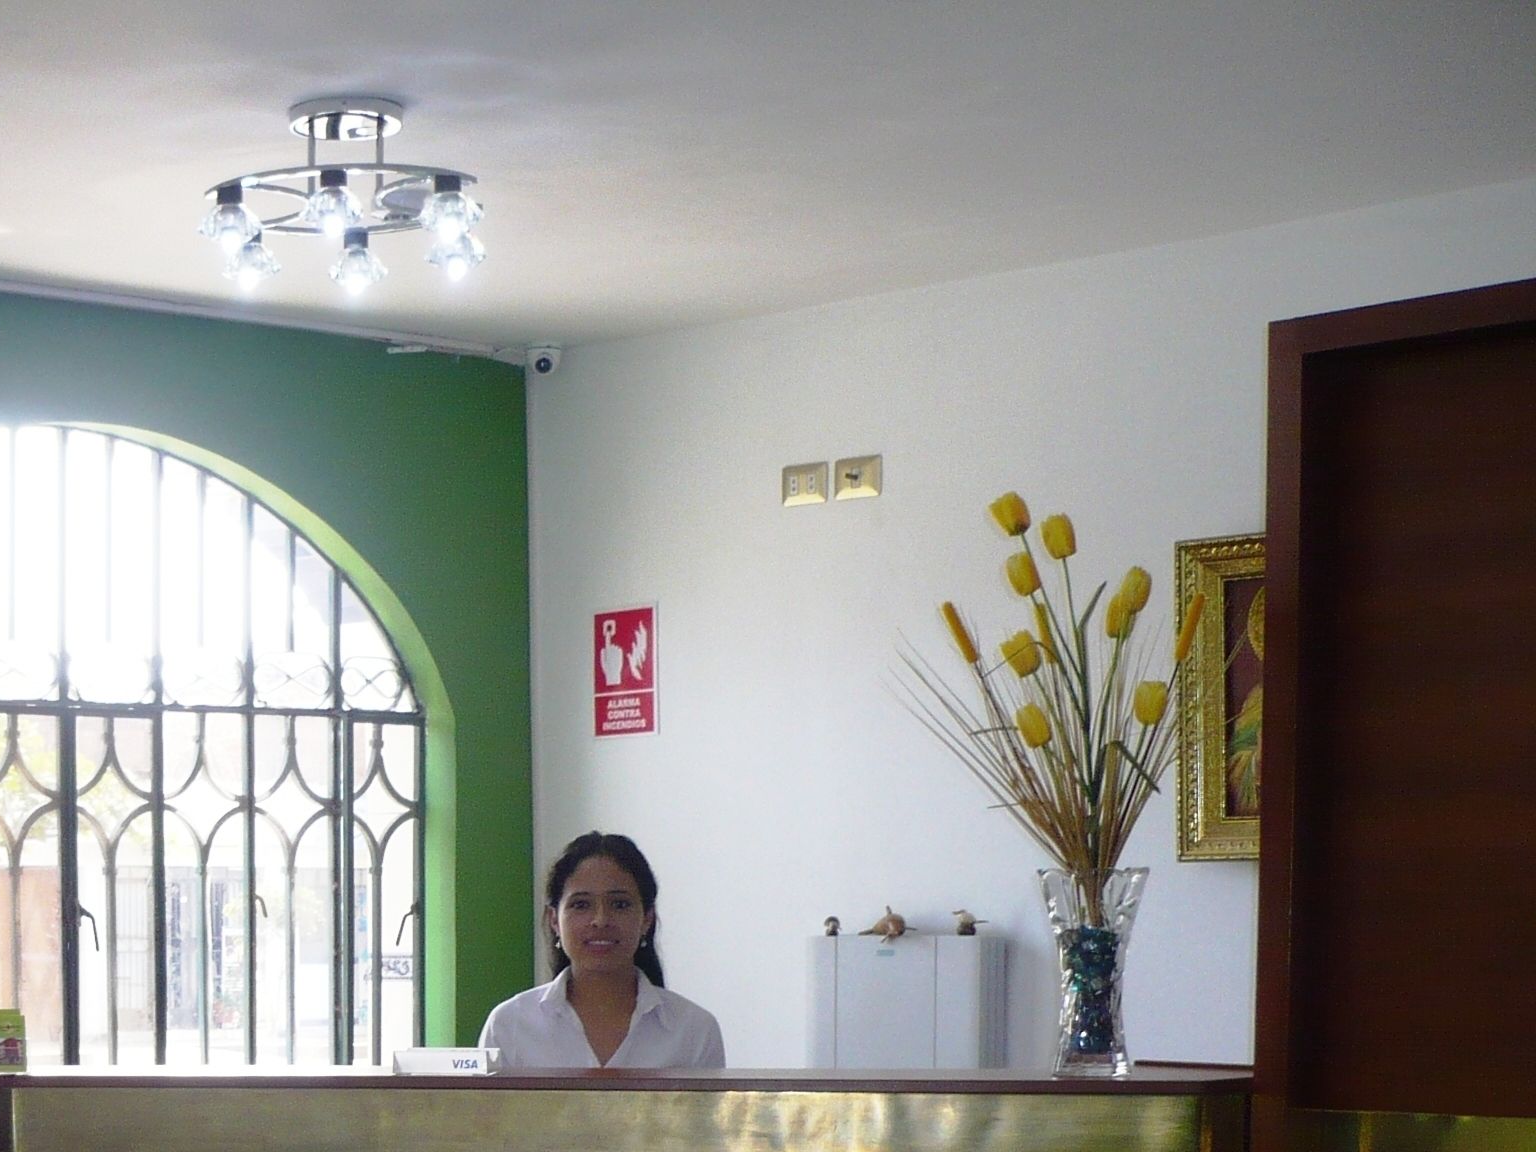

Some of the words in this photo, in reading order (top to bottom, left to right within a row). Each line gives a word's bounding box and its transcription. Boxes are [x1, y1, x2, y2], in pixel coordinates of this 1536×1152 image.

[607, 698, 640, 709] ALARMA
[607, 708, 641, 719] CONTRA
[602, 719, 646, 730] INCENDIOS
[452, 1059, 478, 1069] VISA
